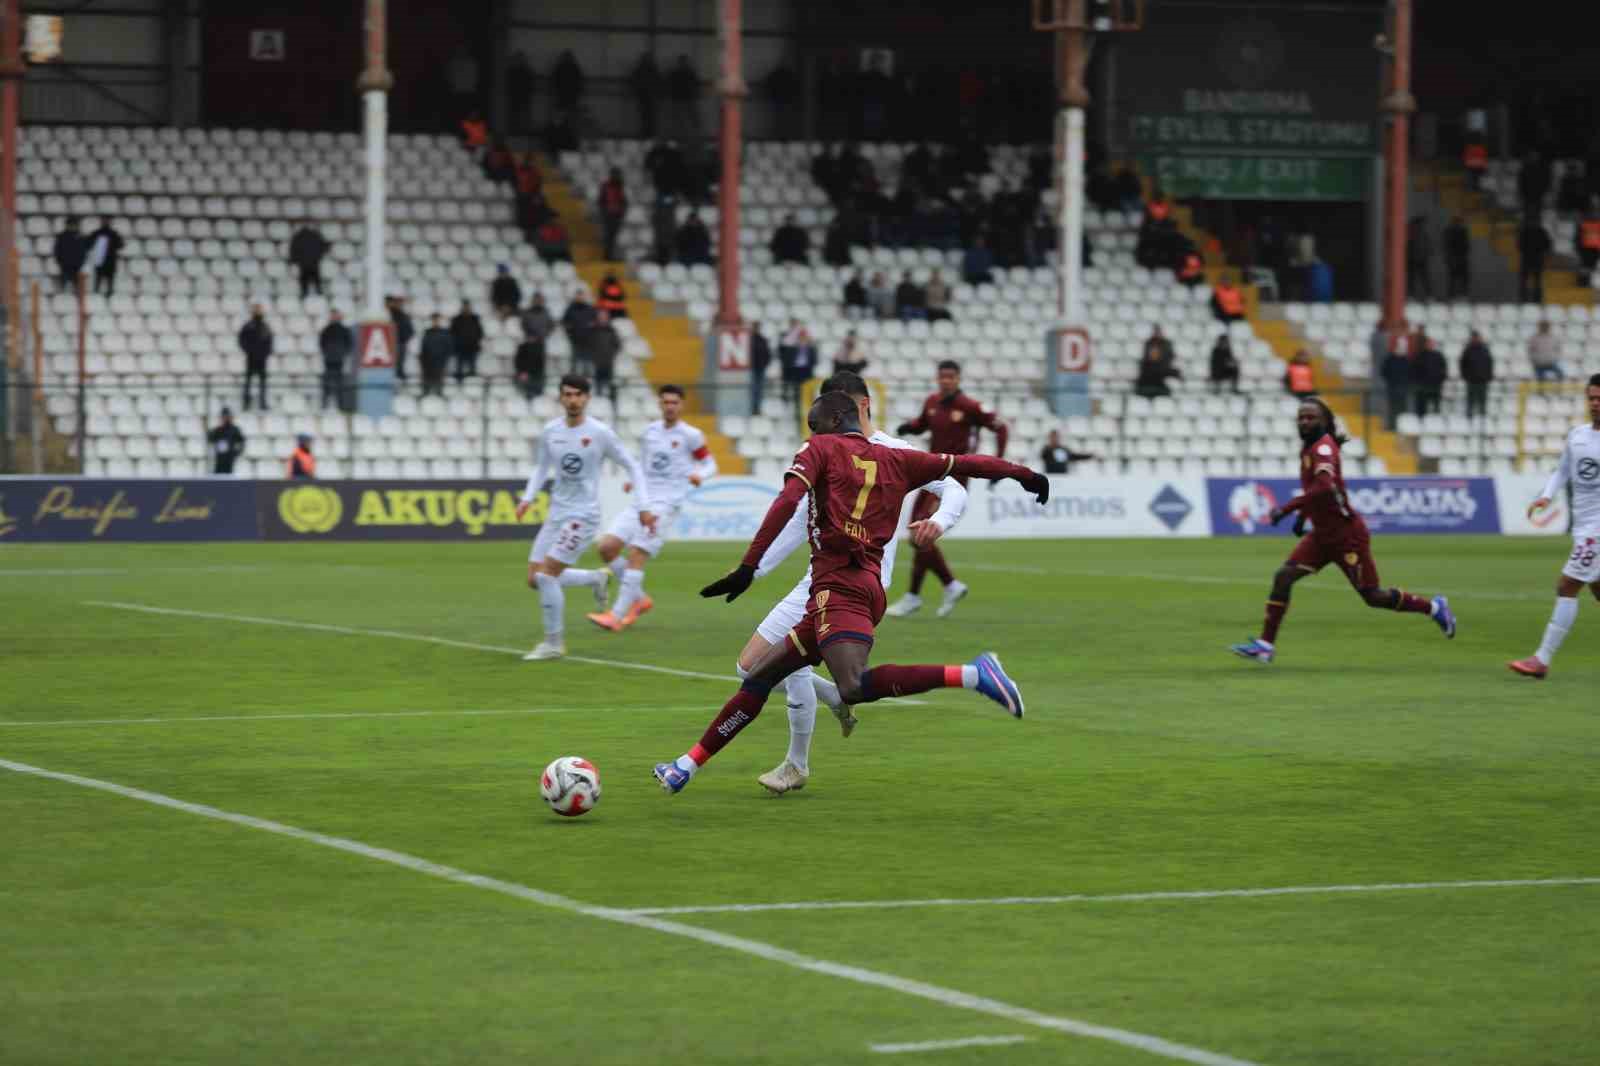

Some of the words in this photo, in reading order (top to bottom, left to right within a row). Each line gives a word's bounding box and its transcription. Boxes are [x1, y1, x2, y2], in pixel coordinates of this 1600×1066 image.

[363, 328, 392, 364] A
[720, 331, 749, 367] N
[1060, 332, 1088, 369] D
[851, 454, 877, 520] 7
